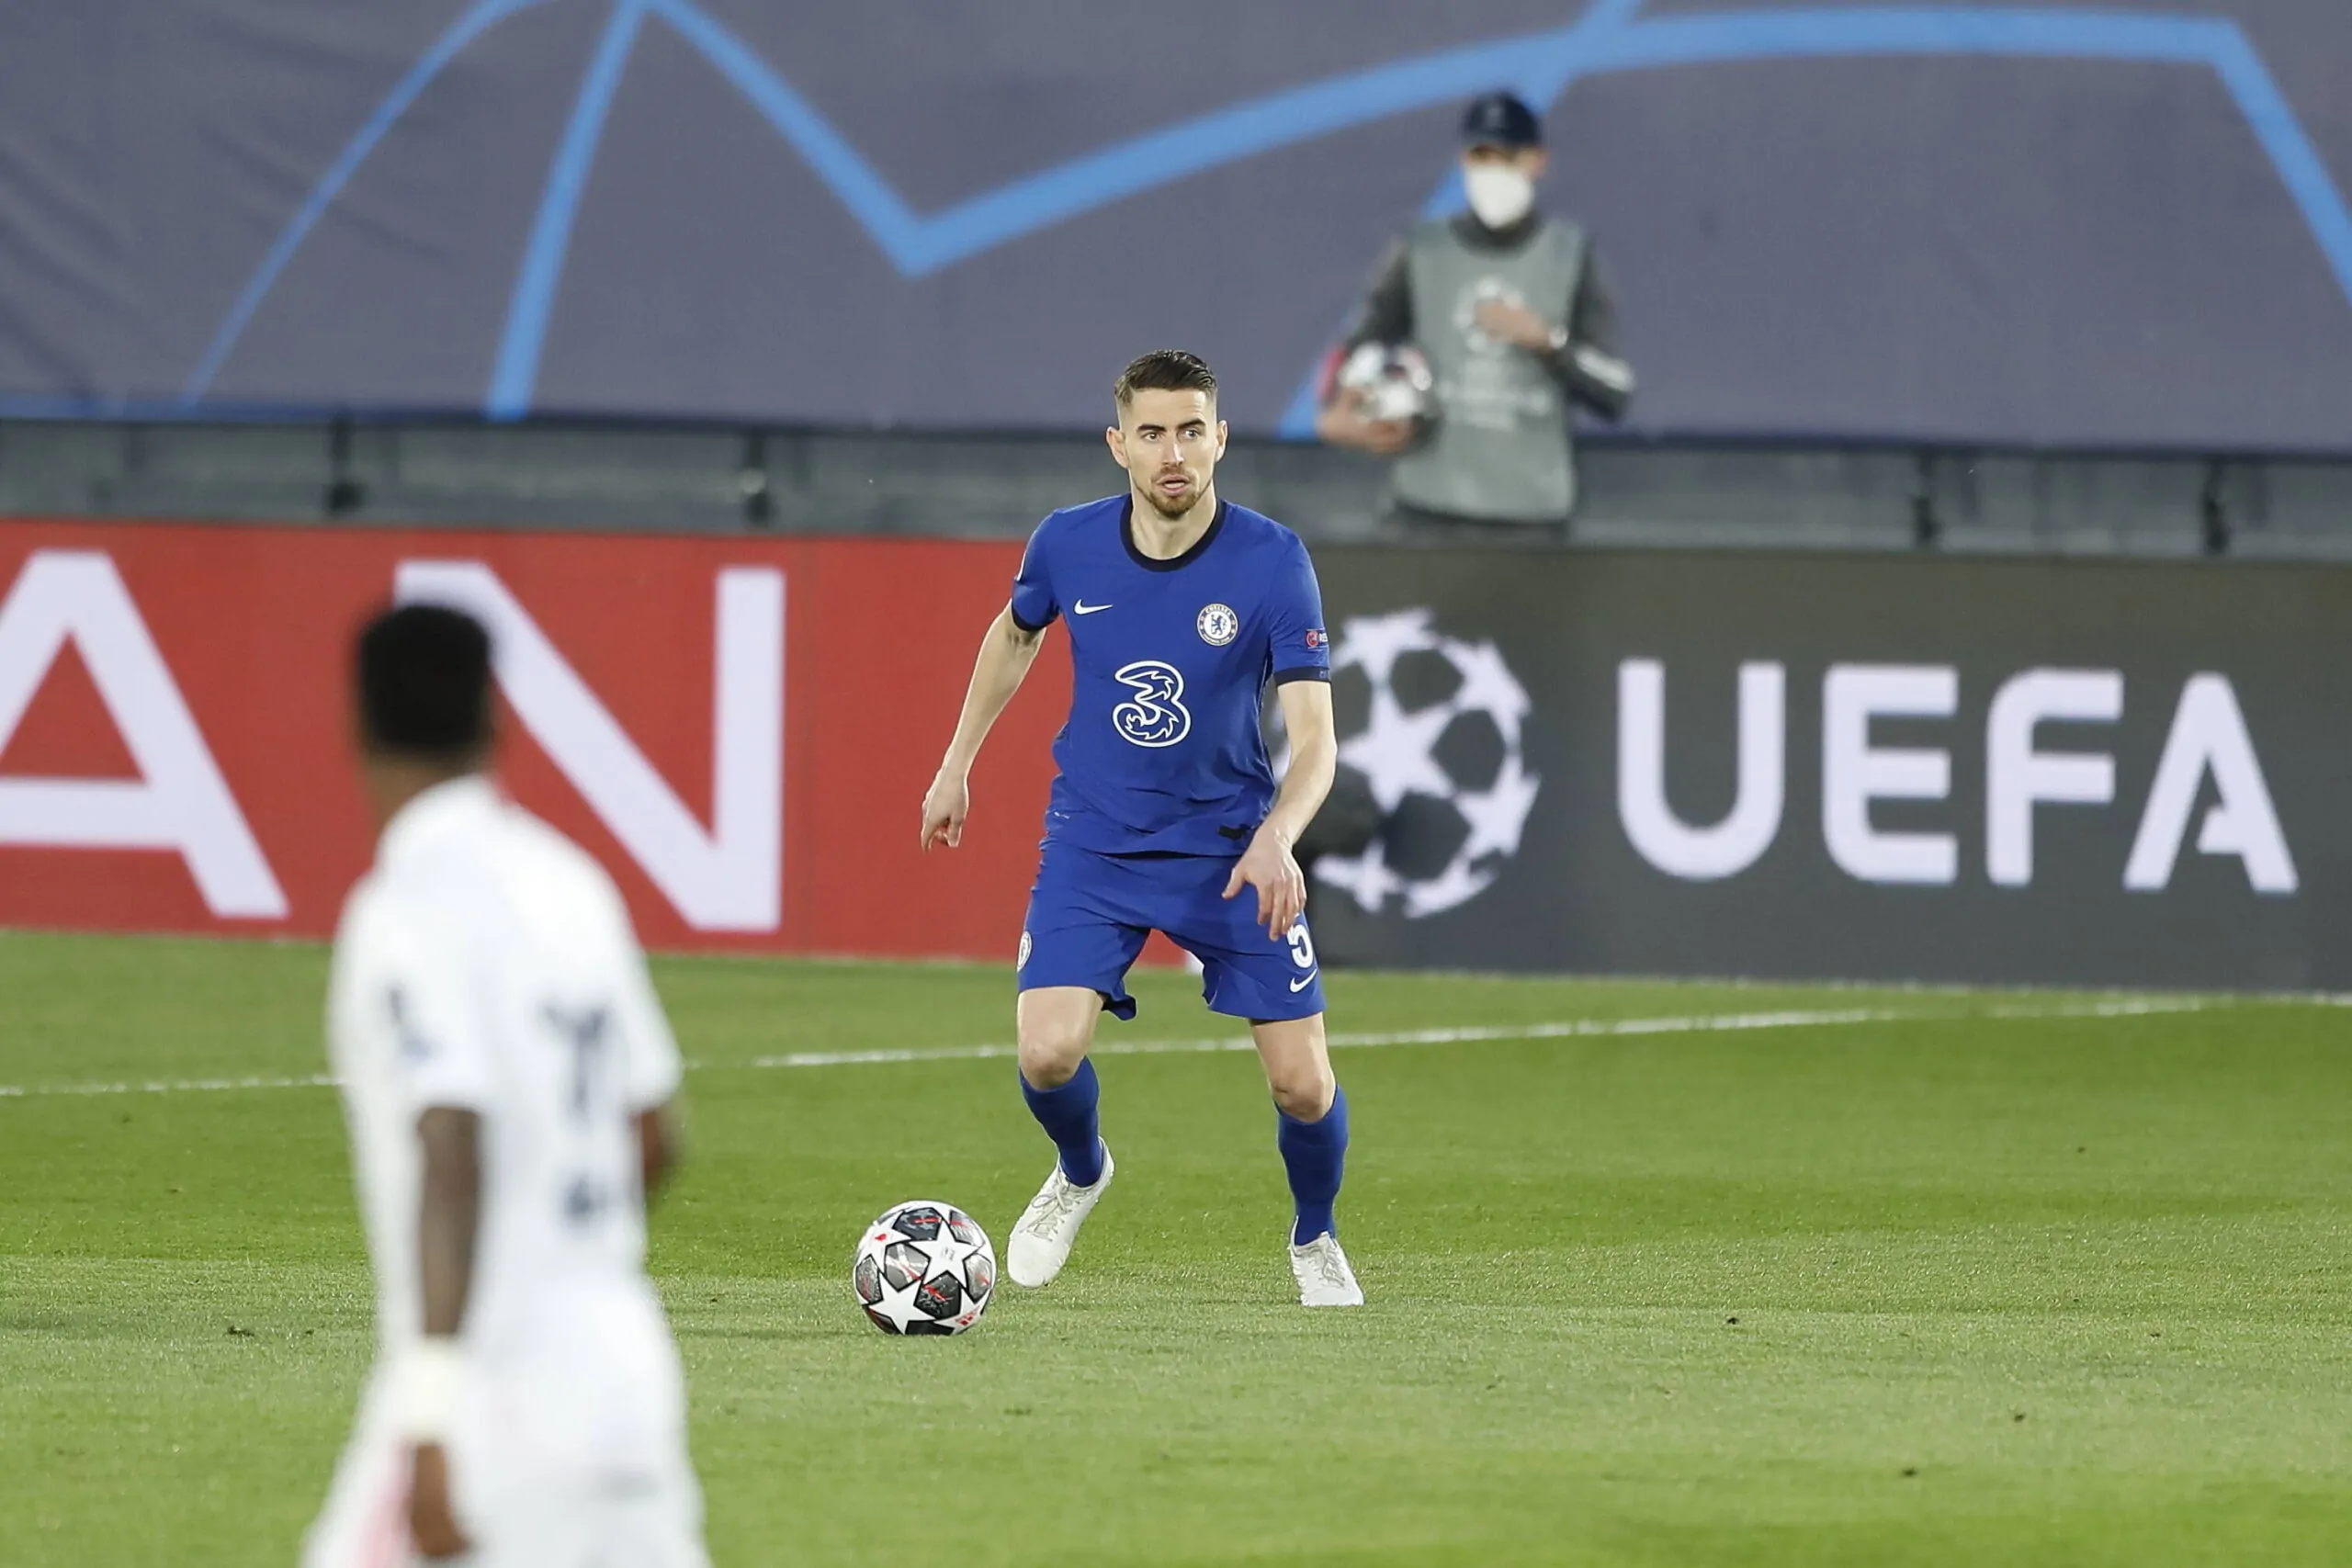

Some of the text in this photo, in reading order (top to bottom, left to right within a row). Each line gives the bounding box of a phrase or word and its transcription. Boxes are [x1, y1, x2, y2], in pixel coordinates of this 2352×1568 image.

[1113, 660, 1191, 748] 3
[1618, 658, 2299, 893] UEFA
[1286, 913, 1314, 968] 5
